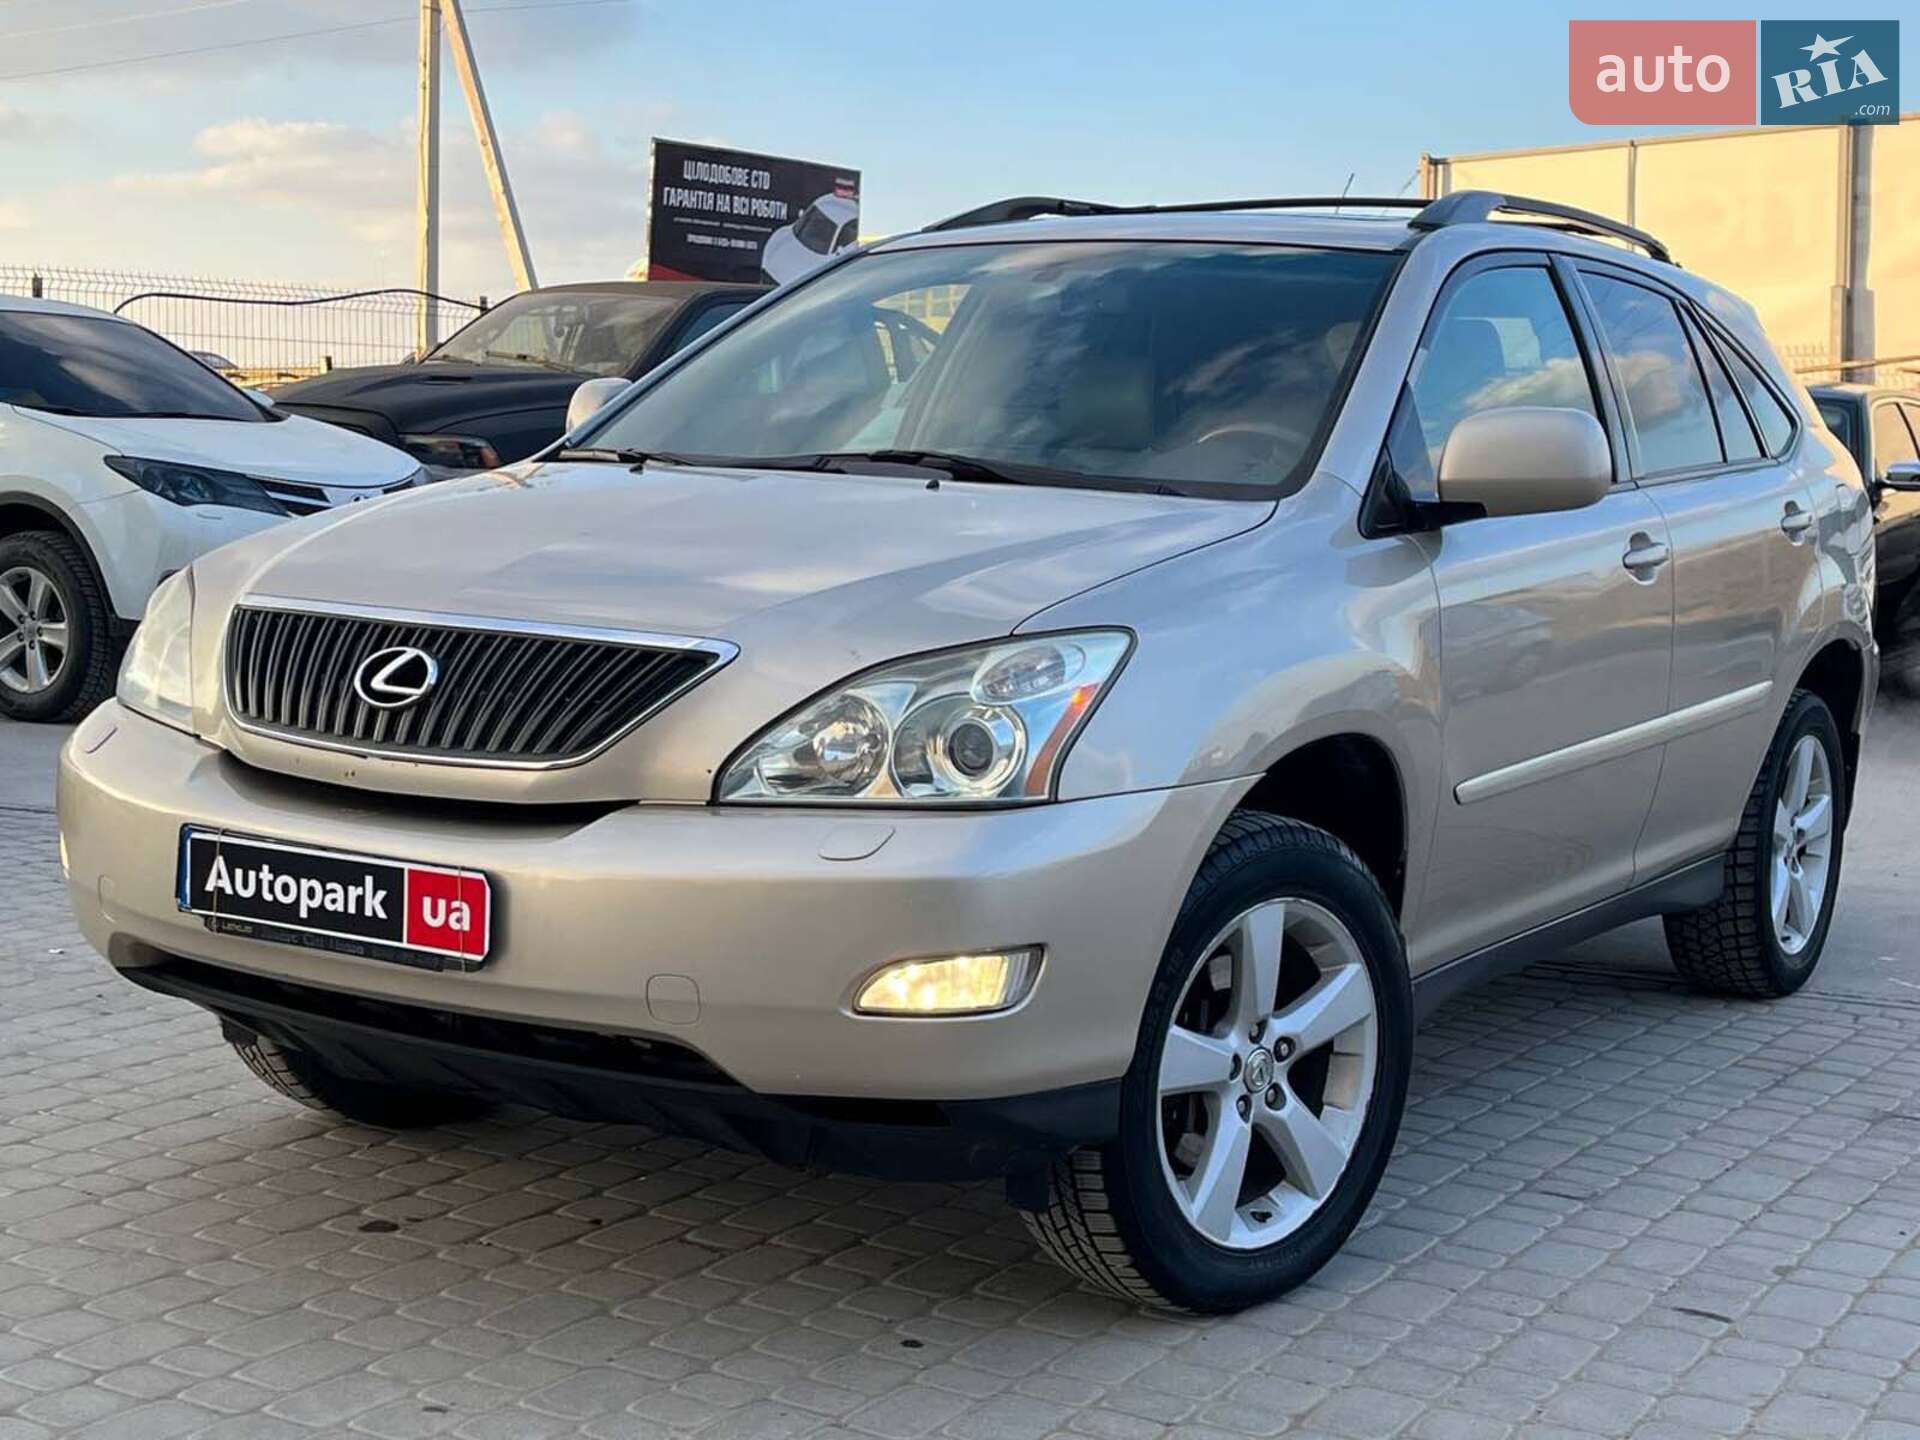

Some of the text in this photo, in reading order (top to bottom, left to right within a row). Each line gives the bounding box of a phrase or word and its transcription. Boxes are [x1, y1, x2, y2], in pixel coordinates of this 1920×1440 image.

[683, 160, 771, 190] ЦІЛОДОБОВЕ СТО
[663, 187, 787, 220] ГАРАНТІЯ НА ВСІ РОБОТИ
[204, 856, 471, 931] Autopark ua
